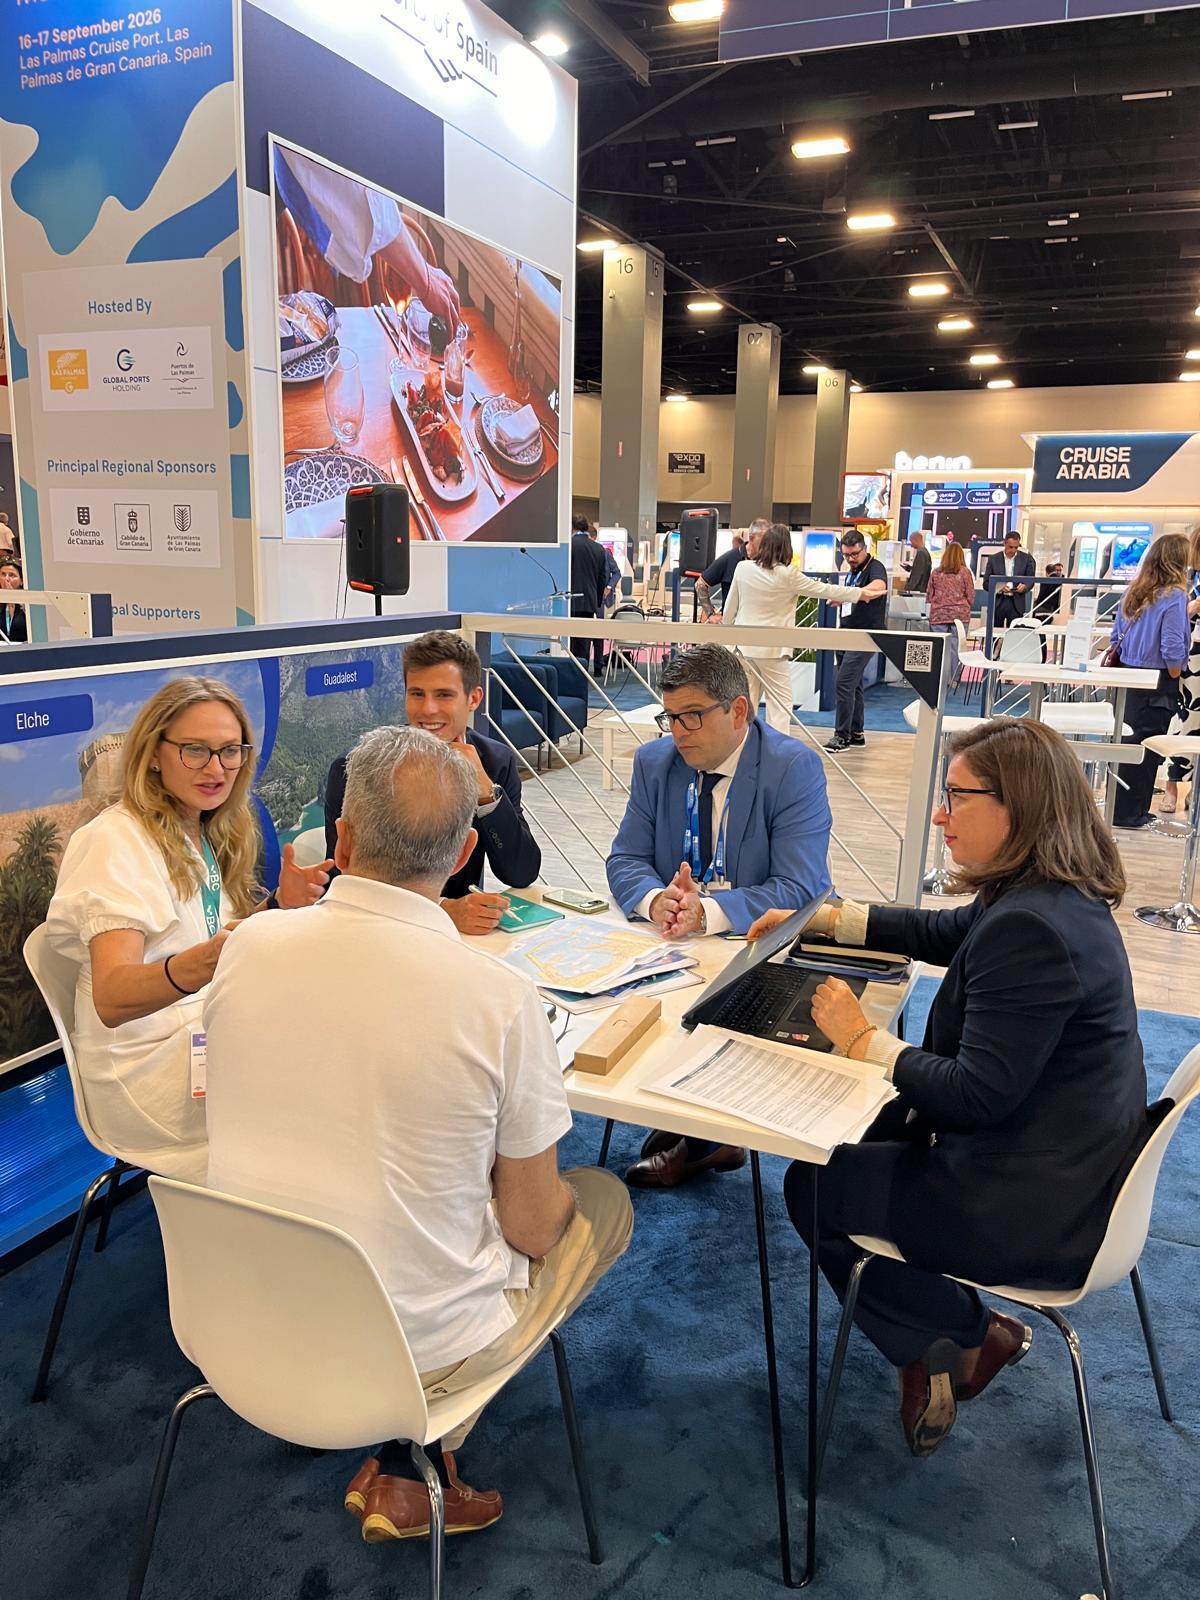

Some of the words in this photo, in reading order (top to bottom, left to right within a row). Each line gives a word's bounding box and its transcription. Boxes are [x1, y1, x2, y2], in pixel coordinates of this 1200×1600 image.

[19, 31, 49, 49] 16-17
[52, 18, 124, 44] September
[128, 8, 162, 29] 2026
[20, 53, 39, 69] Las
[43, 46, 86, 66] Palmas
[89, 37, 129, 57] Cruise
[166, 27, 190, 42] Las
[456, 22, 498, 75] Spain
[21, 68, 62, 89] Palmas
[66, 64, 82, 81] de
[85, 60, 116, 78] Gran
[175, 42, 212, 64] Spain
[617, 257, 634, 274] 16
[88, 299, 133, 315] Hosted
[136, 298, 152, 316] By
[747, 332, 763, 345] 07
[51, 368, 62, 376] LAS
[63, 368, 86, 376] PALMAS
[129, 376, 150, 384] PORTS
[825, 377, 839, 388] 06
[1060, 447, 1131, 463] CRUISE
[48, 460, 99, 476] Principal
[102, 460, 154, 476] Regional
[157, 460, 217, 476] Sponsors
[1056, 464, 1130, 480] ARABIA
[70, 529, 100, 537] Gobierno
[67, 537, 75, 545] de
[76, 538, 104, 546] Canarias
[112, 604, 129, 619] pal
[132, 604, 201, 620] Supporters
[323, 670, 357, 686] Guadalest
[16, 712, 50, 730] Elche
